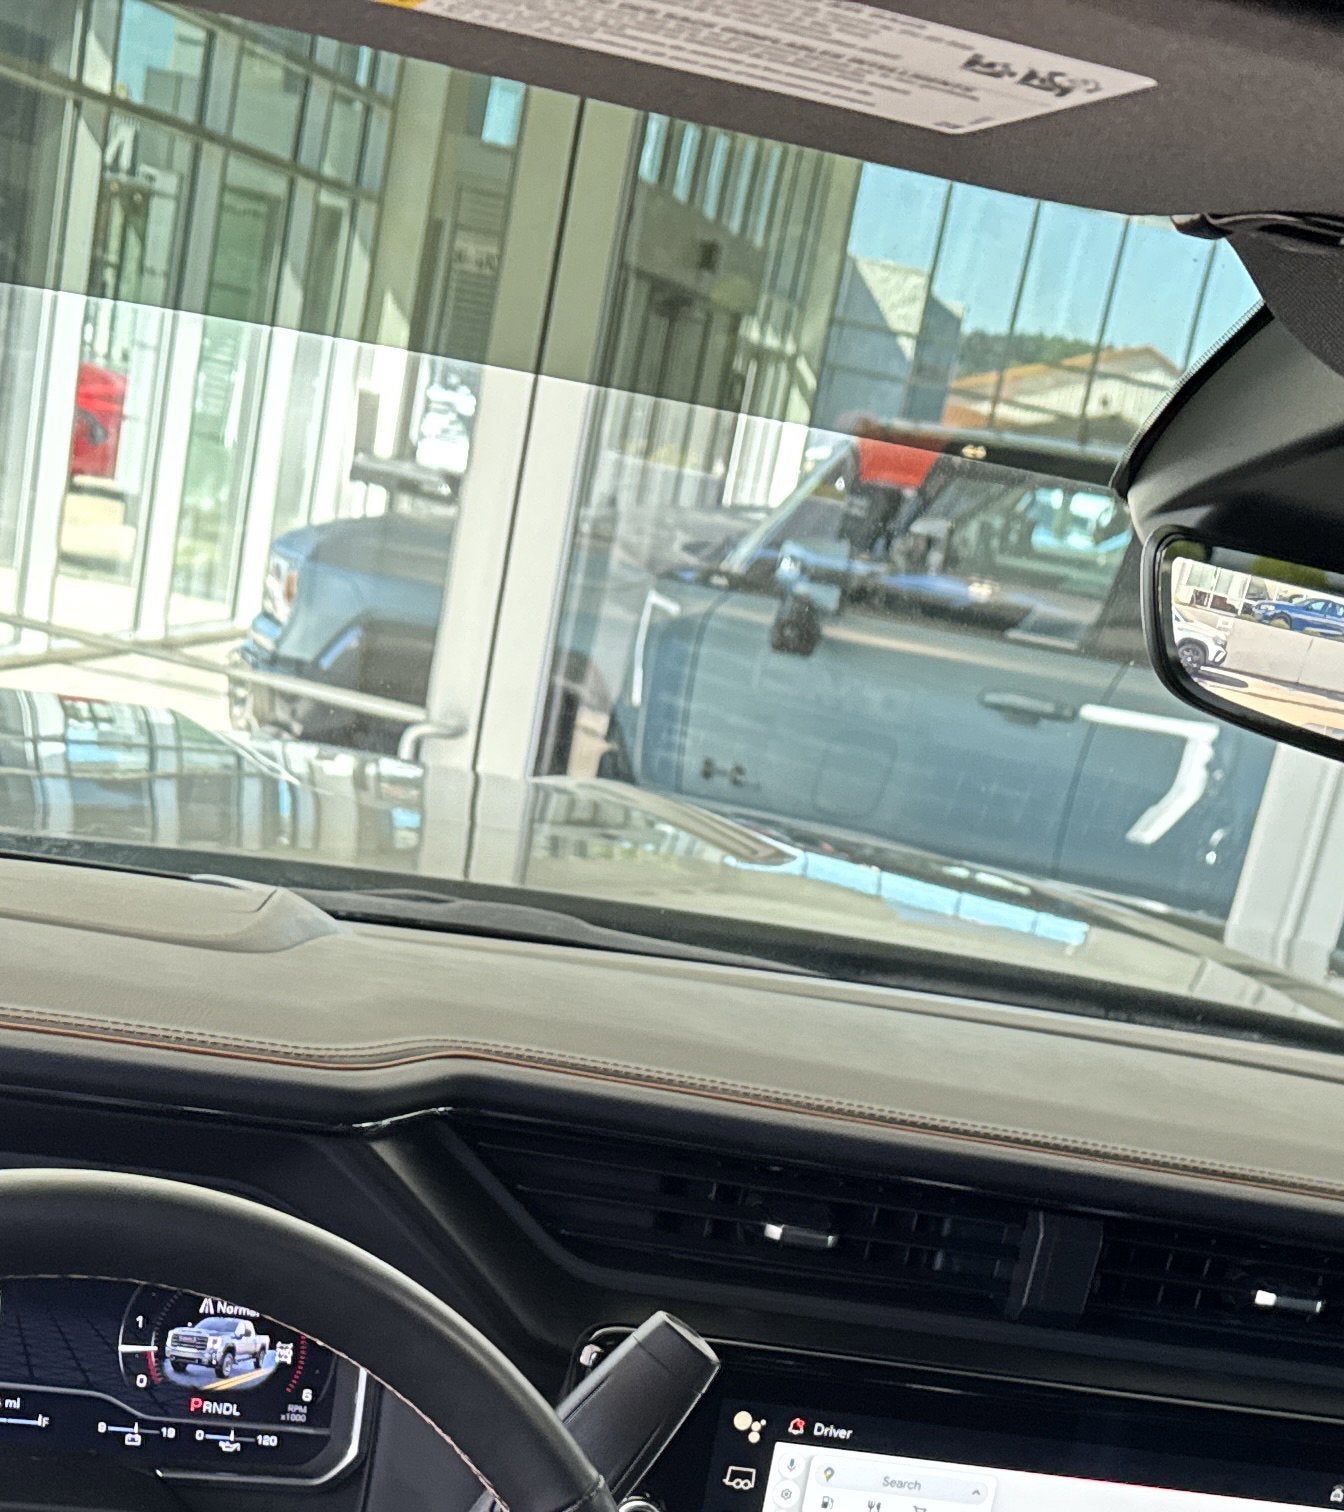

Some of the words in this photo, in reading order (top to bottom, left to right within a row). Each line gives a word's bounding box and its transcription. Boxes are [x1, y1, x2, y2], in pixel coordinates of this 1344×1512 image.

[216, 1301, 260, 1318] Norma
[136, 1315, 144, 1328] 1
[136, 1373, 148, 1388] 0
[5, 1397, 21, 1409] mi
[287, 1404, 307, 1413] RPM
[813, 1422, 853, 1440] Driver
[882, 1475, 922, 1491] Search
